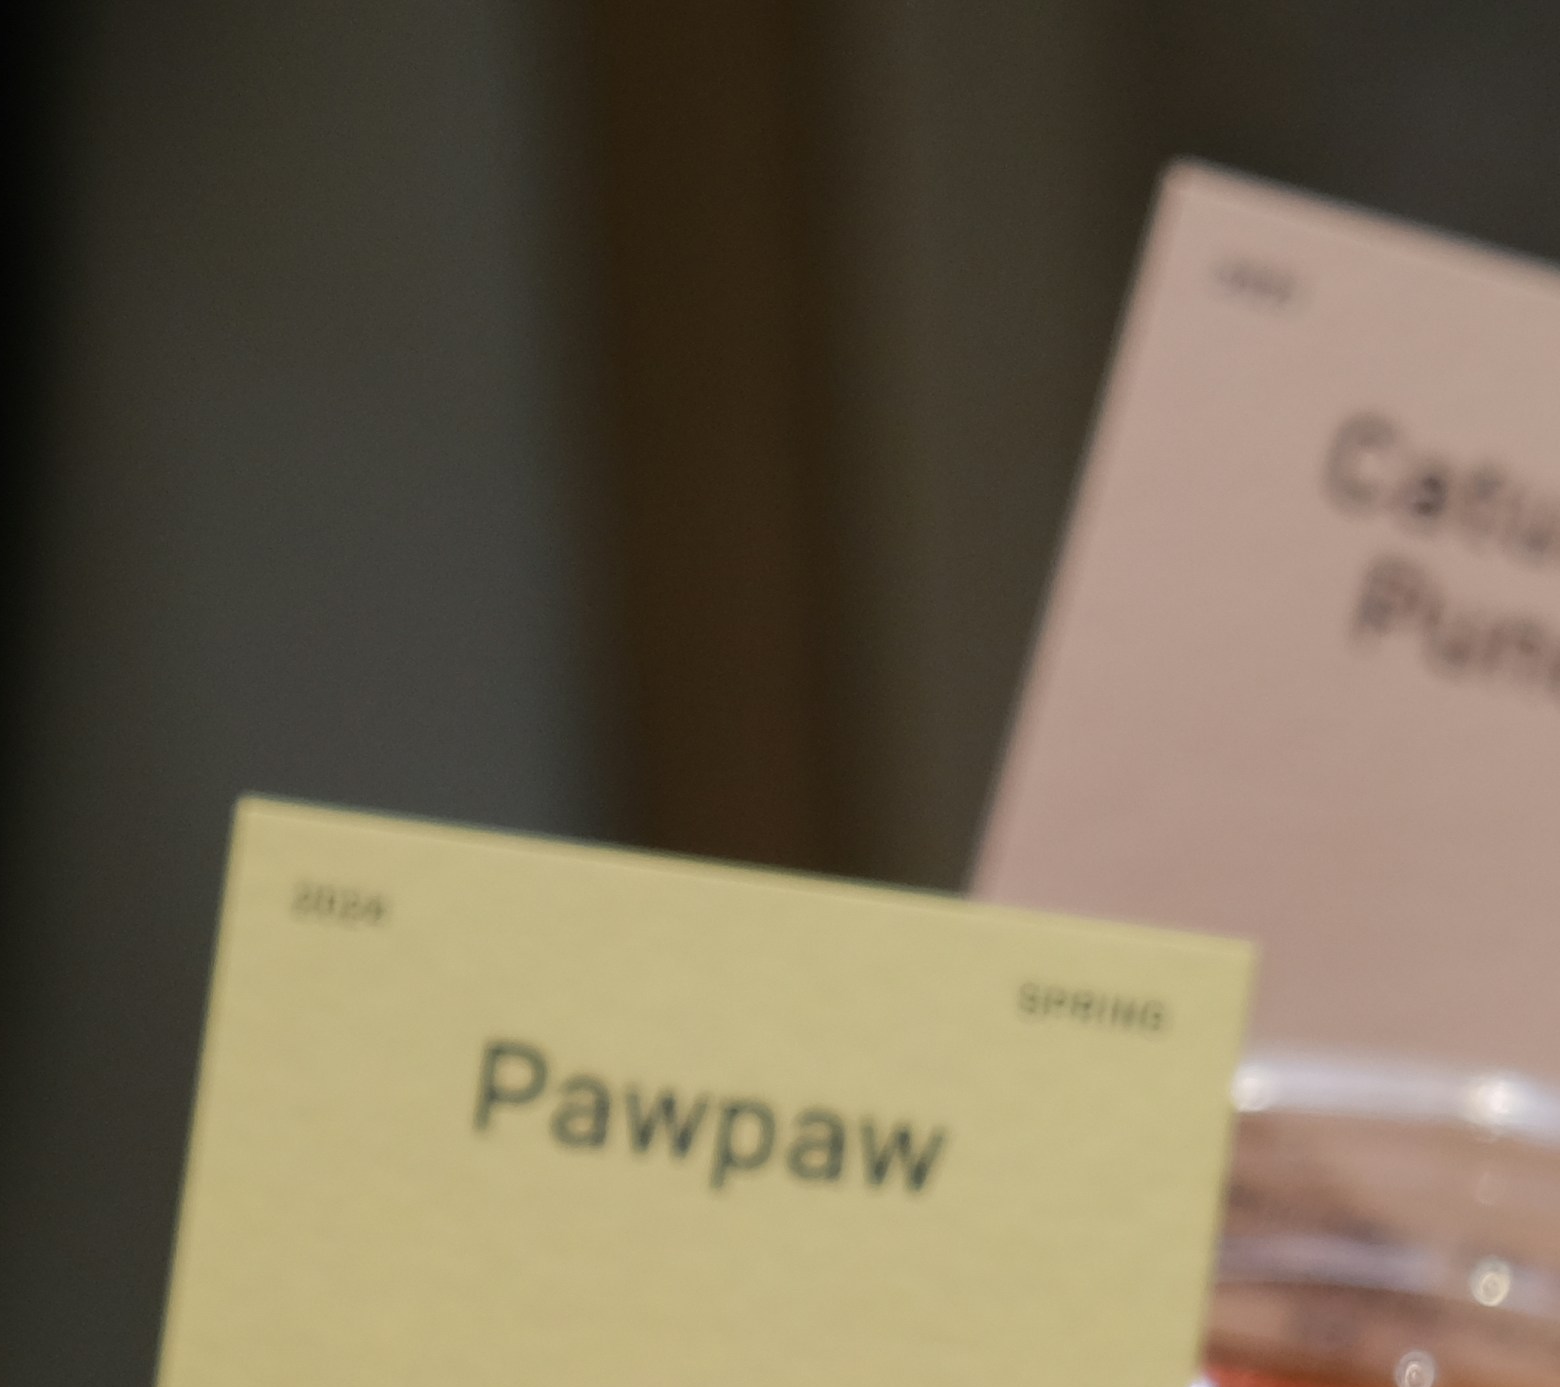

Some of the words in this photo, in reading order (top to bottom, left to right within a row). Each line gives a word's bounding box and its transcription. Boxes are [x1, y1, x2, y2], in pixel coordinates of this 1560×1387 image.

[289, 880, 391, 929] 2024
[1016, 980, 1169, 1034] SPRING
[472, 1037, 947, 1194] Pawpaw
